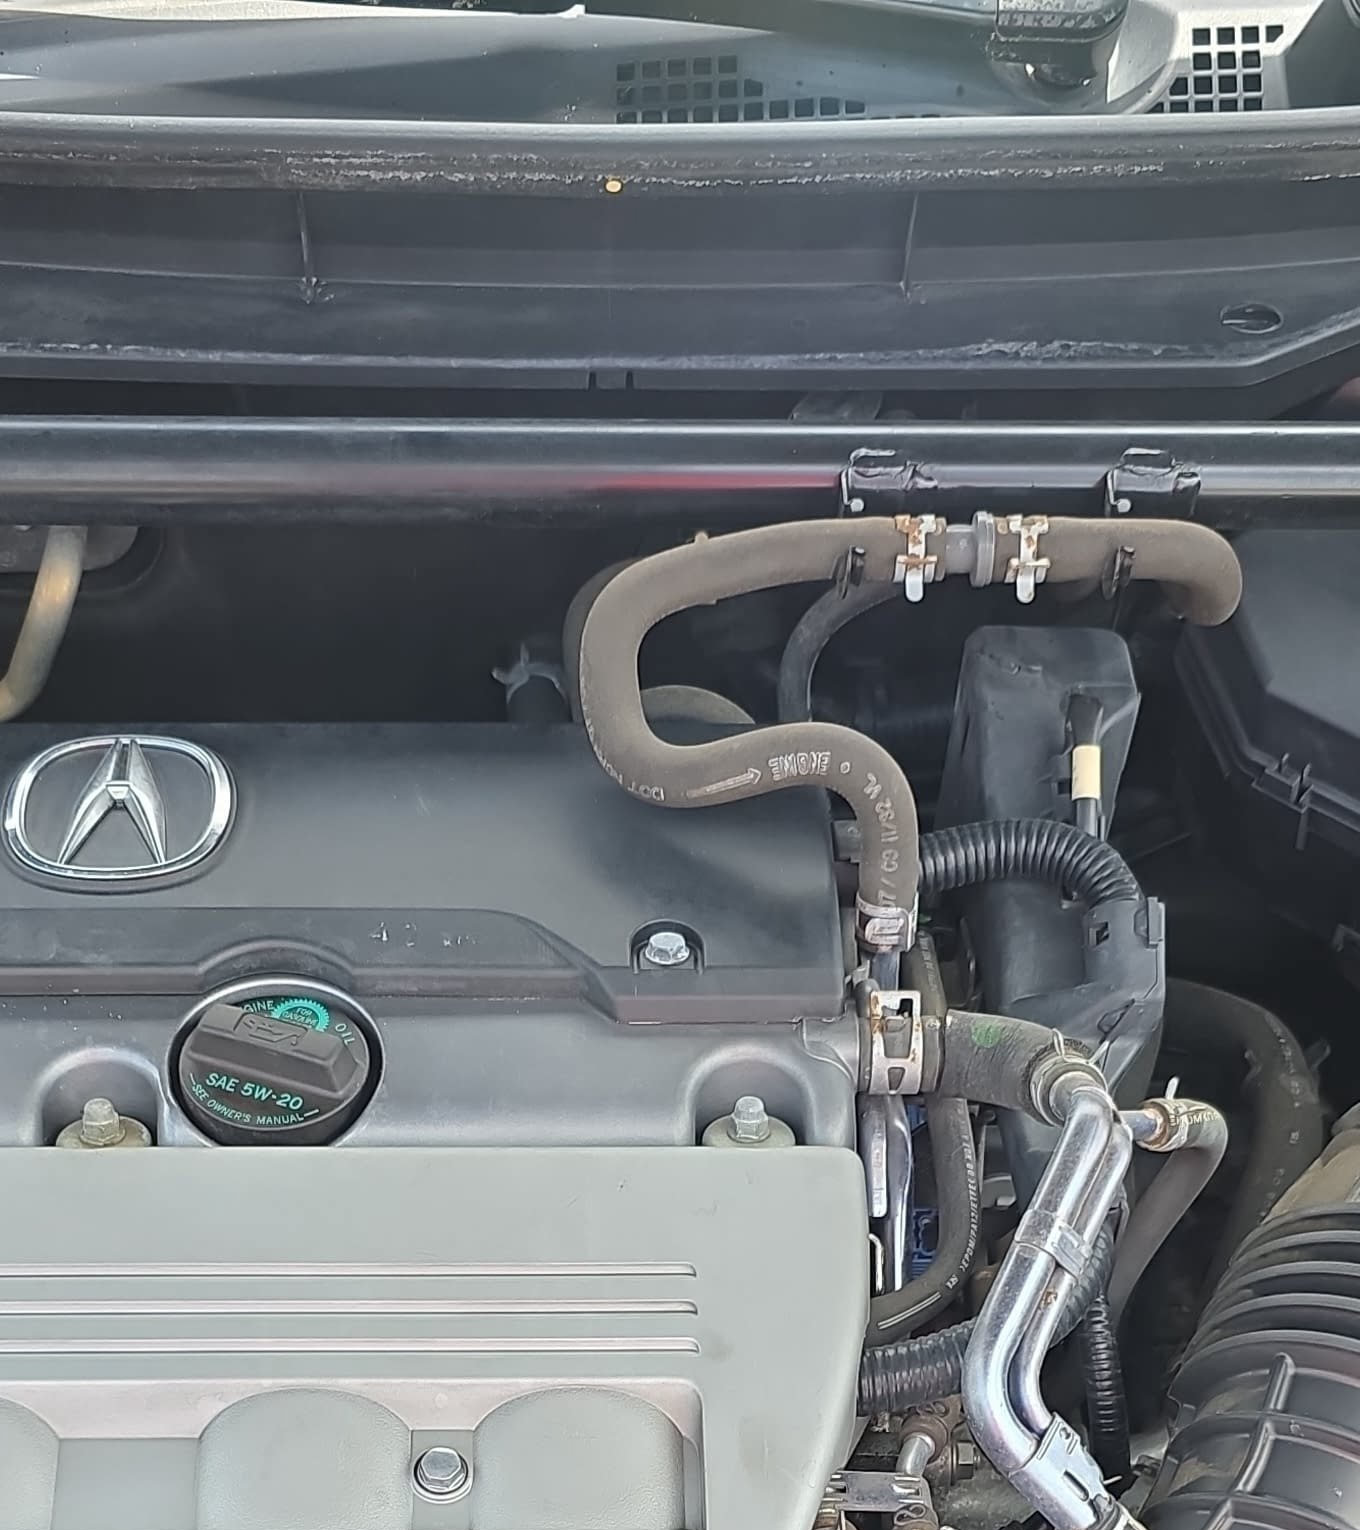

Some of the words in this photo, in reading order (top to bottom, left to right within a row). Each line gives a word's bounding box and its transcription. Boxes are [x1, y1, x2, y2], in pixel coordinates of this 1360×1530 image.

[241, 999, 275, 1015] GINE
[334, 1021, 357, 1047] OIL
[192, 1083, 210, 1102] SEE
[206, 1098, 252, 1124] OWNER'S
[256, 1112, 305, 1126] MANUAL
[205, 1072, 240, 1093] SAE
[241, 1082, 304, 1111] 5W-20
